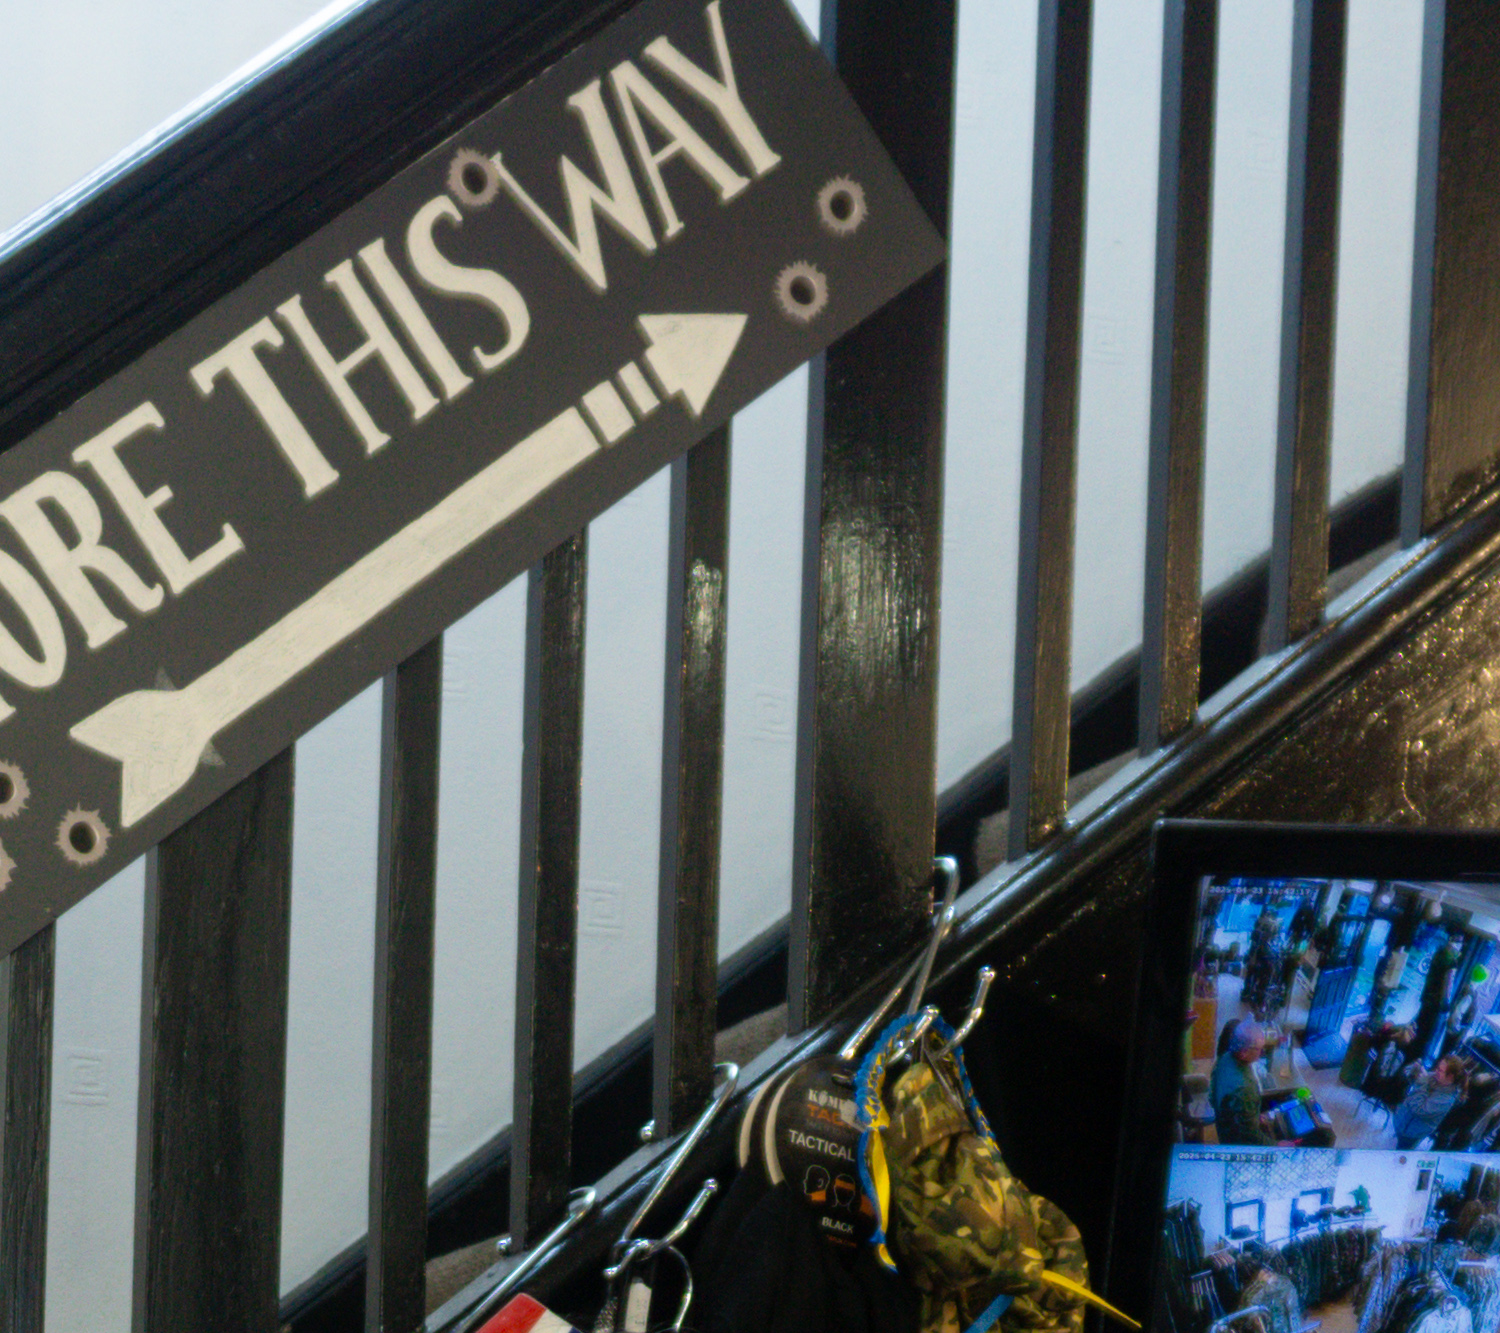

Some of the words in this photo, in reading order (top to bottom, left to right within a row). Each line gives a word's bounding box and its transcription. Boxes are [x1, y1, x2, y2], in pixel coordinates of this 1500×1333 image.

[190, 195, 531, 498] THIS
[490, 0, 782, 290] WAY
[788, 1128, 856, 1163] TACTICAL
[822, 1216, 854, 1234] BLACK
